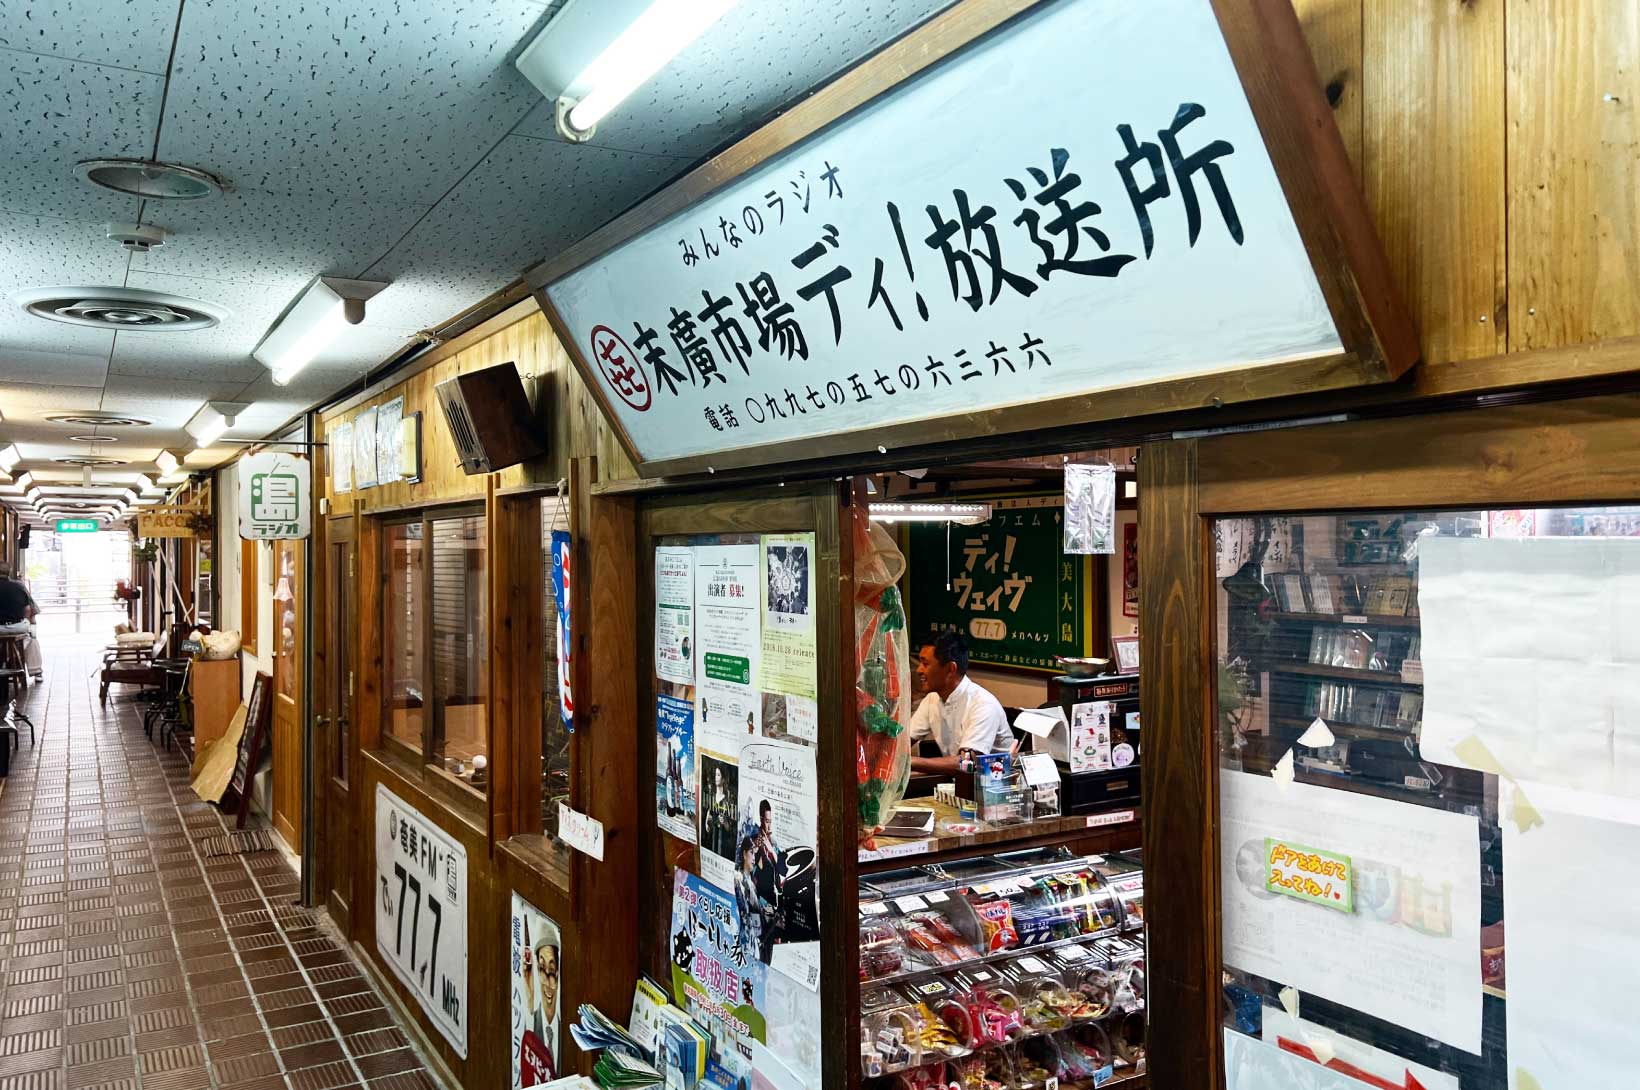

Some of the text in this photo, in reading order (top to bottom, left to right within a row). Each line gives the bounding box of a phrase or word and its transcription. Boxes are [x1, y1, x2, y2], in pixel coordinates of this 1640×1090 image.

[679, 161, 843, 267] みんなのラジオ
[704, 403, 740, 431] 電話
[252, 523, 299, 535] ラジオ
[963, 533, 1017, 573] ディ!
[1061, 558, 1073, 644] 美大島
[183, 643, 200, 651] OPEN
[975, 621, 1001, 638] 77.7
[1269, 844, 1346, 880] ドアをあけて
[1269, 868, 1333, 897] 入ってね!
[695, 947, 738, 1004] 取扱店
[442, 973, 460, 1027] MHz
